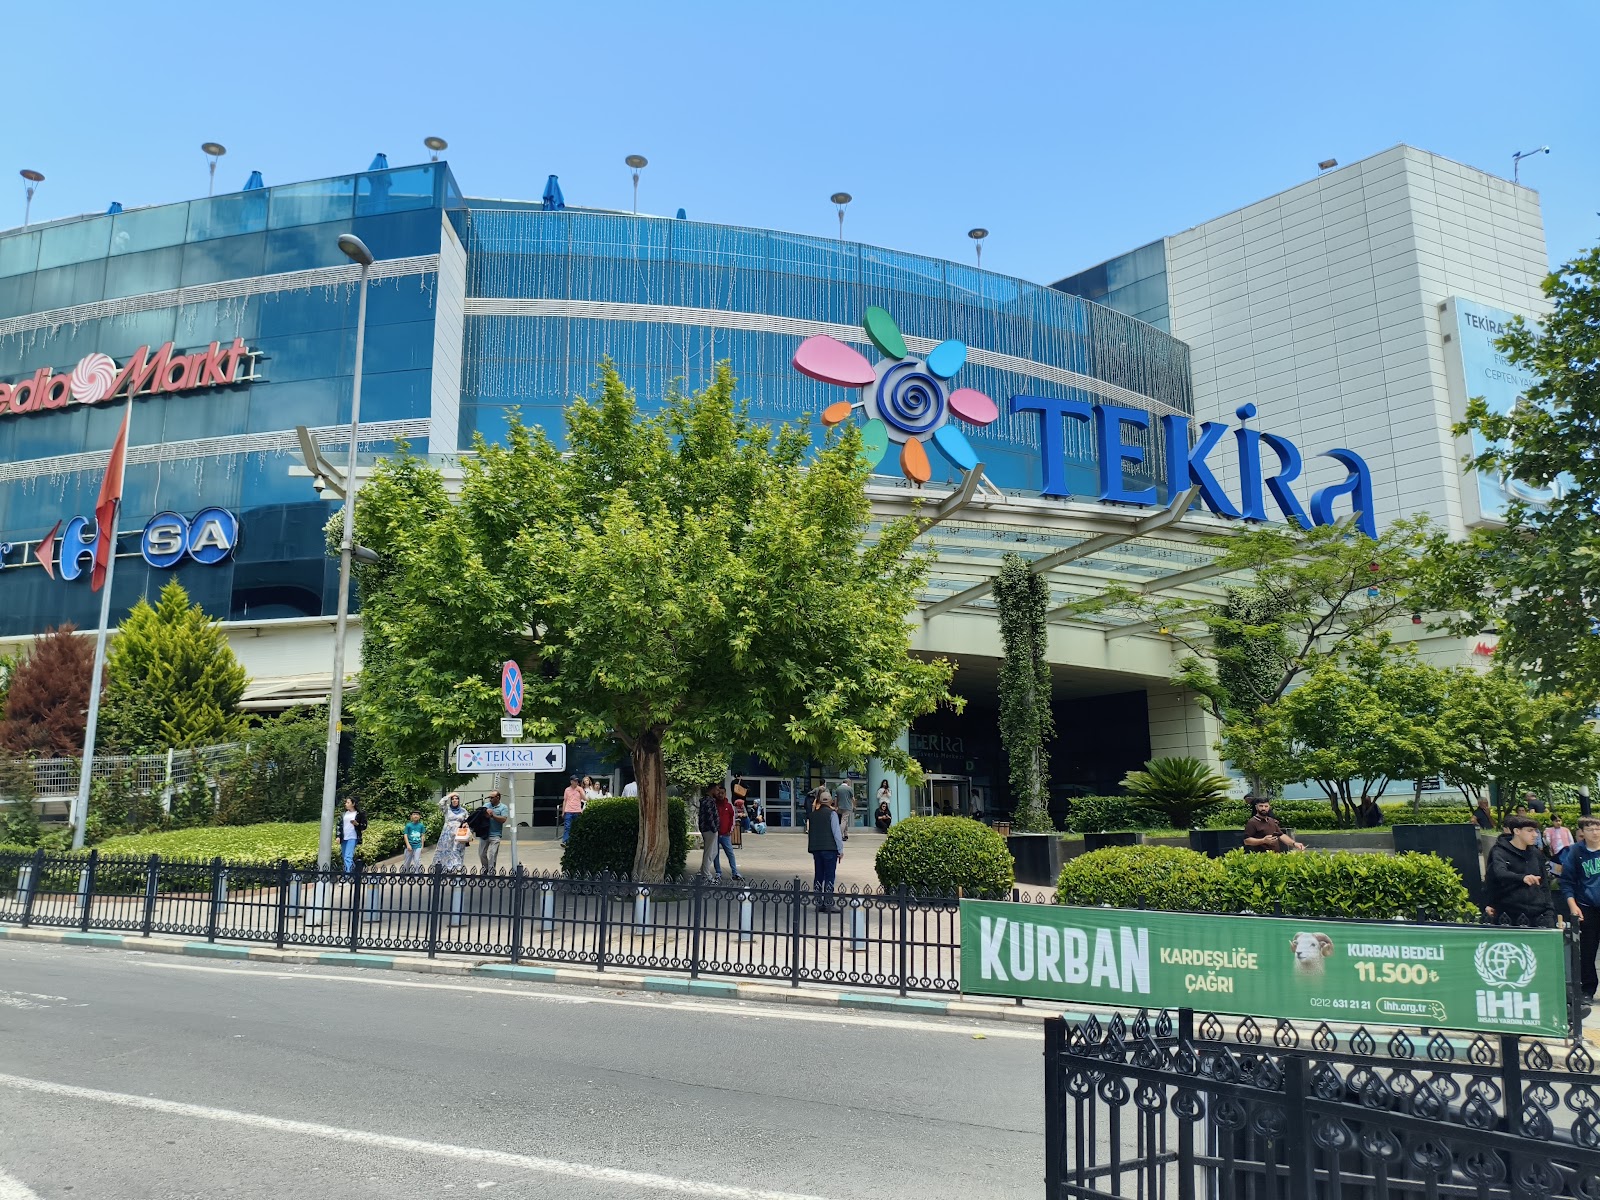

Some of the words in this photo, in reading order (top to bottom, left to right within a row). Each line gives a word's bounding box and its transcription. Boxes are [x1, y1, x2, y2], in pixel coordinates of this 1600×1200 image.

[1465, 312, 1504, 335] TEKİRA
[101, 337, 249, 402] Markt
[1484, 368, 1518, 385] CEPTEN
[146, 516, 233, 558] SA
[965, 761, 974, 770] D
[980, 916, 1151, 994] KURBAN
[1160, 948, 1258, 971] KARDEŞLİĞE
[1347, 943, 1400, 959] KURBAN
[1401, 944, 1444, 961] BEDELİ
[1185, 971, 1234, 993] ÇAĞRI
[1310, 998, 1331, 1008] 0212
[1332, 999, 1348, 1009] 631
[1349, 1000, 1360, 1009] 21
[1361, 1000, 1371, 1010] 21
[1383, 1000, 1427, 1014] ihh.org.tr
